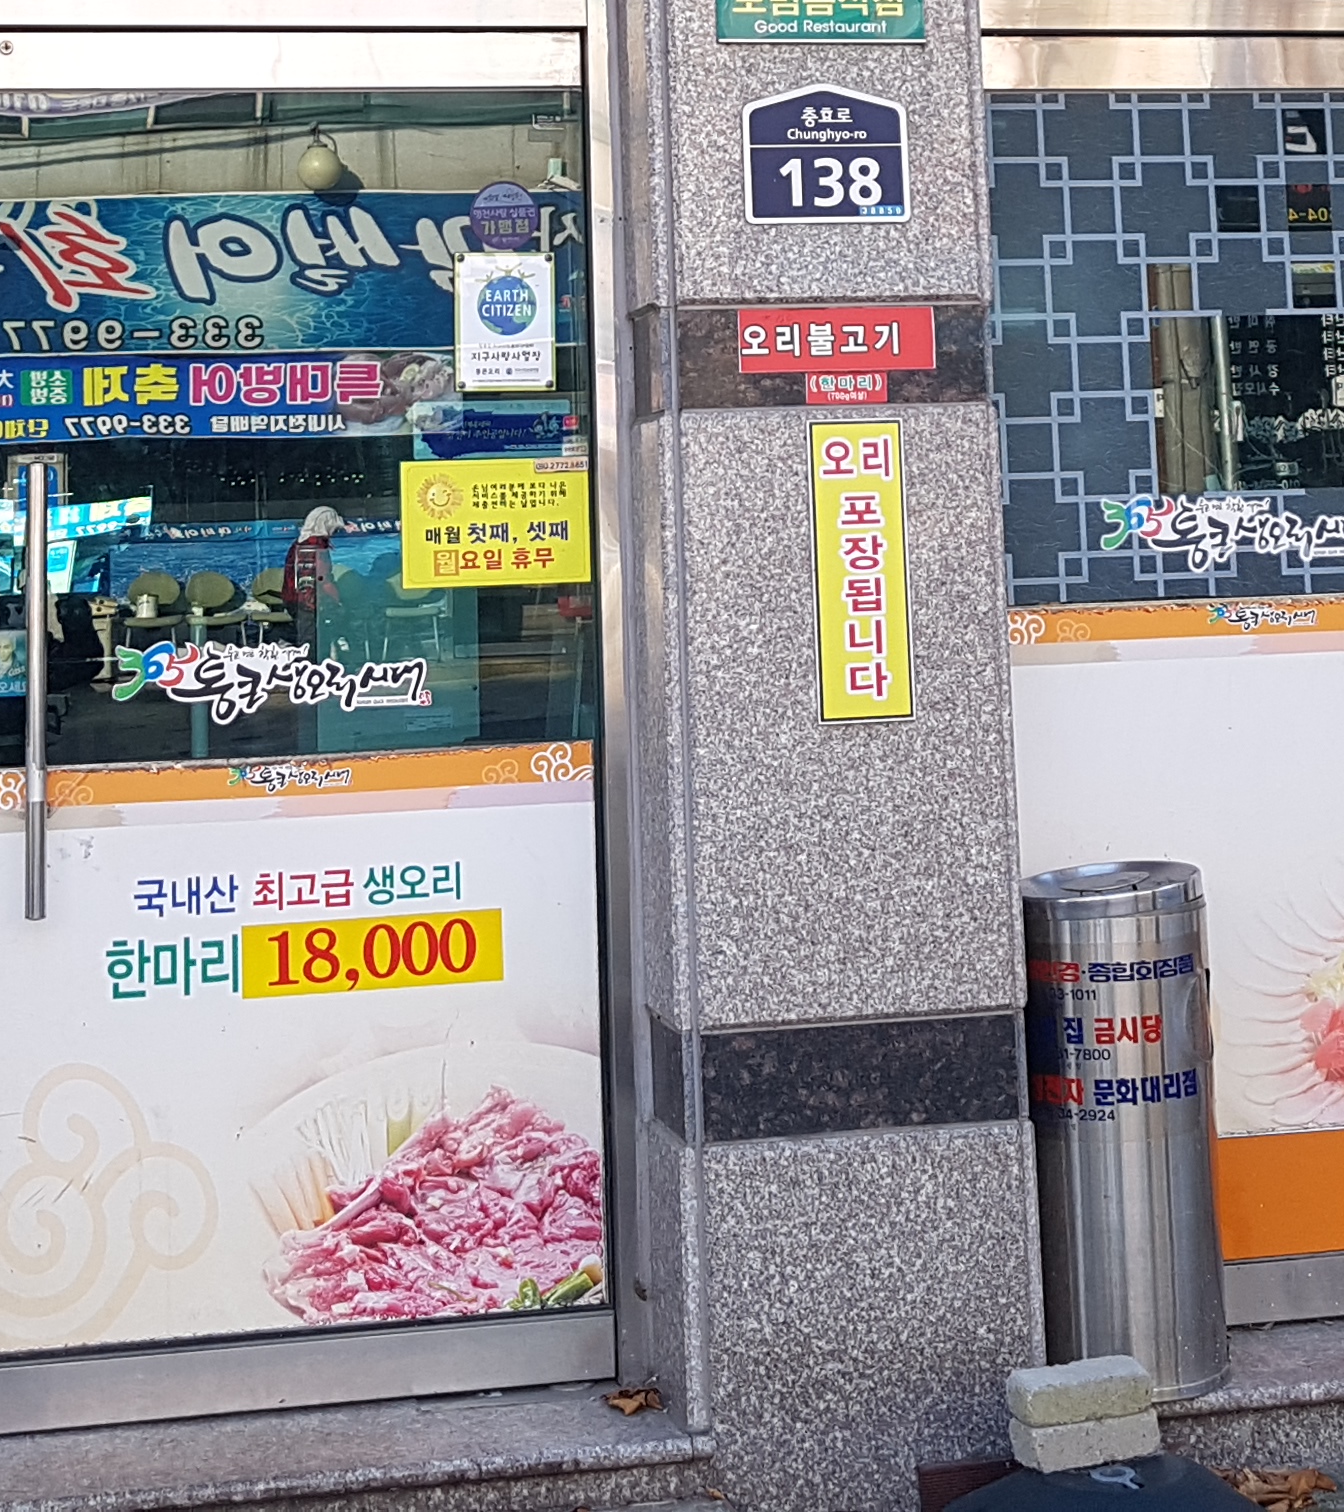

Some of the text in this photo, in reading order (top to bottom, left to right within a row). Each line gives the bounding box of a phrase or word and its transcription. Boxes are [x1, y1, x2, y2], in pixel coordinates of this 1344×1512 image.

[755, 20, 887, 33] Good Restaurant
[801, 107, 853, 127] 충효로
[787, 128, 867, 142] Chunghyo-ro
[779, 157, 882, 207] 138
[481, 218, 529, 235] 가맹점
[485, 289, 529, 302] EARTH
[482, 304, 532, 317] CITIZEN
[740, 321, 900, 357] 오리불고기
[471, 350, 541, 362] 지구사랑사업장
[810, 374, 882, 392] (한마리)
[821, 439, 892, 478] 오리
[425, 520, 568, 545] 매월 첫째, 셋째
[435, 548, 555, 575] 월요일 휴무
[842, 494, 888, 698] 포장됩니다
[133, 861, 462, 917] 국내산 최고급 생오리
[105, 918, 476, 1000] 한마리 18,000
[1094, 1014, 1163, 1045] 금시당
[1094, 1067, 1198, 1106] 문화대리점
